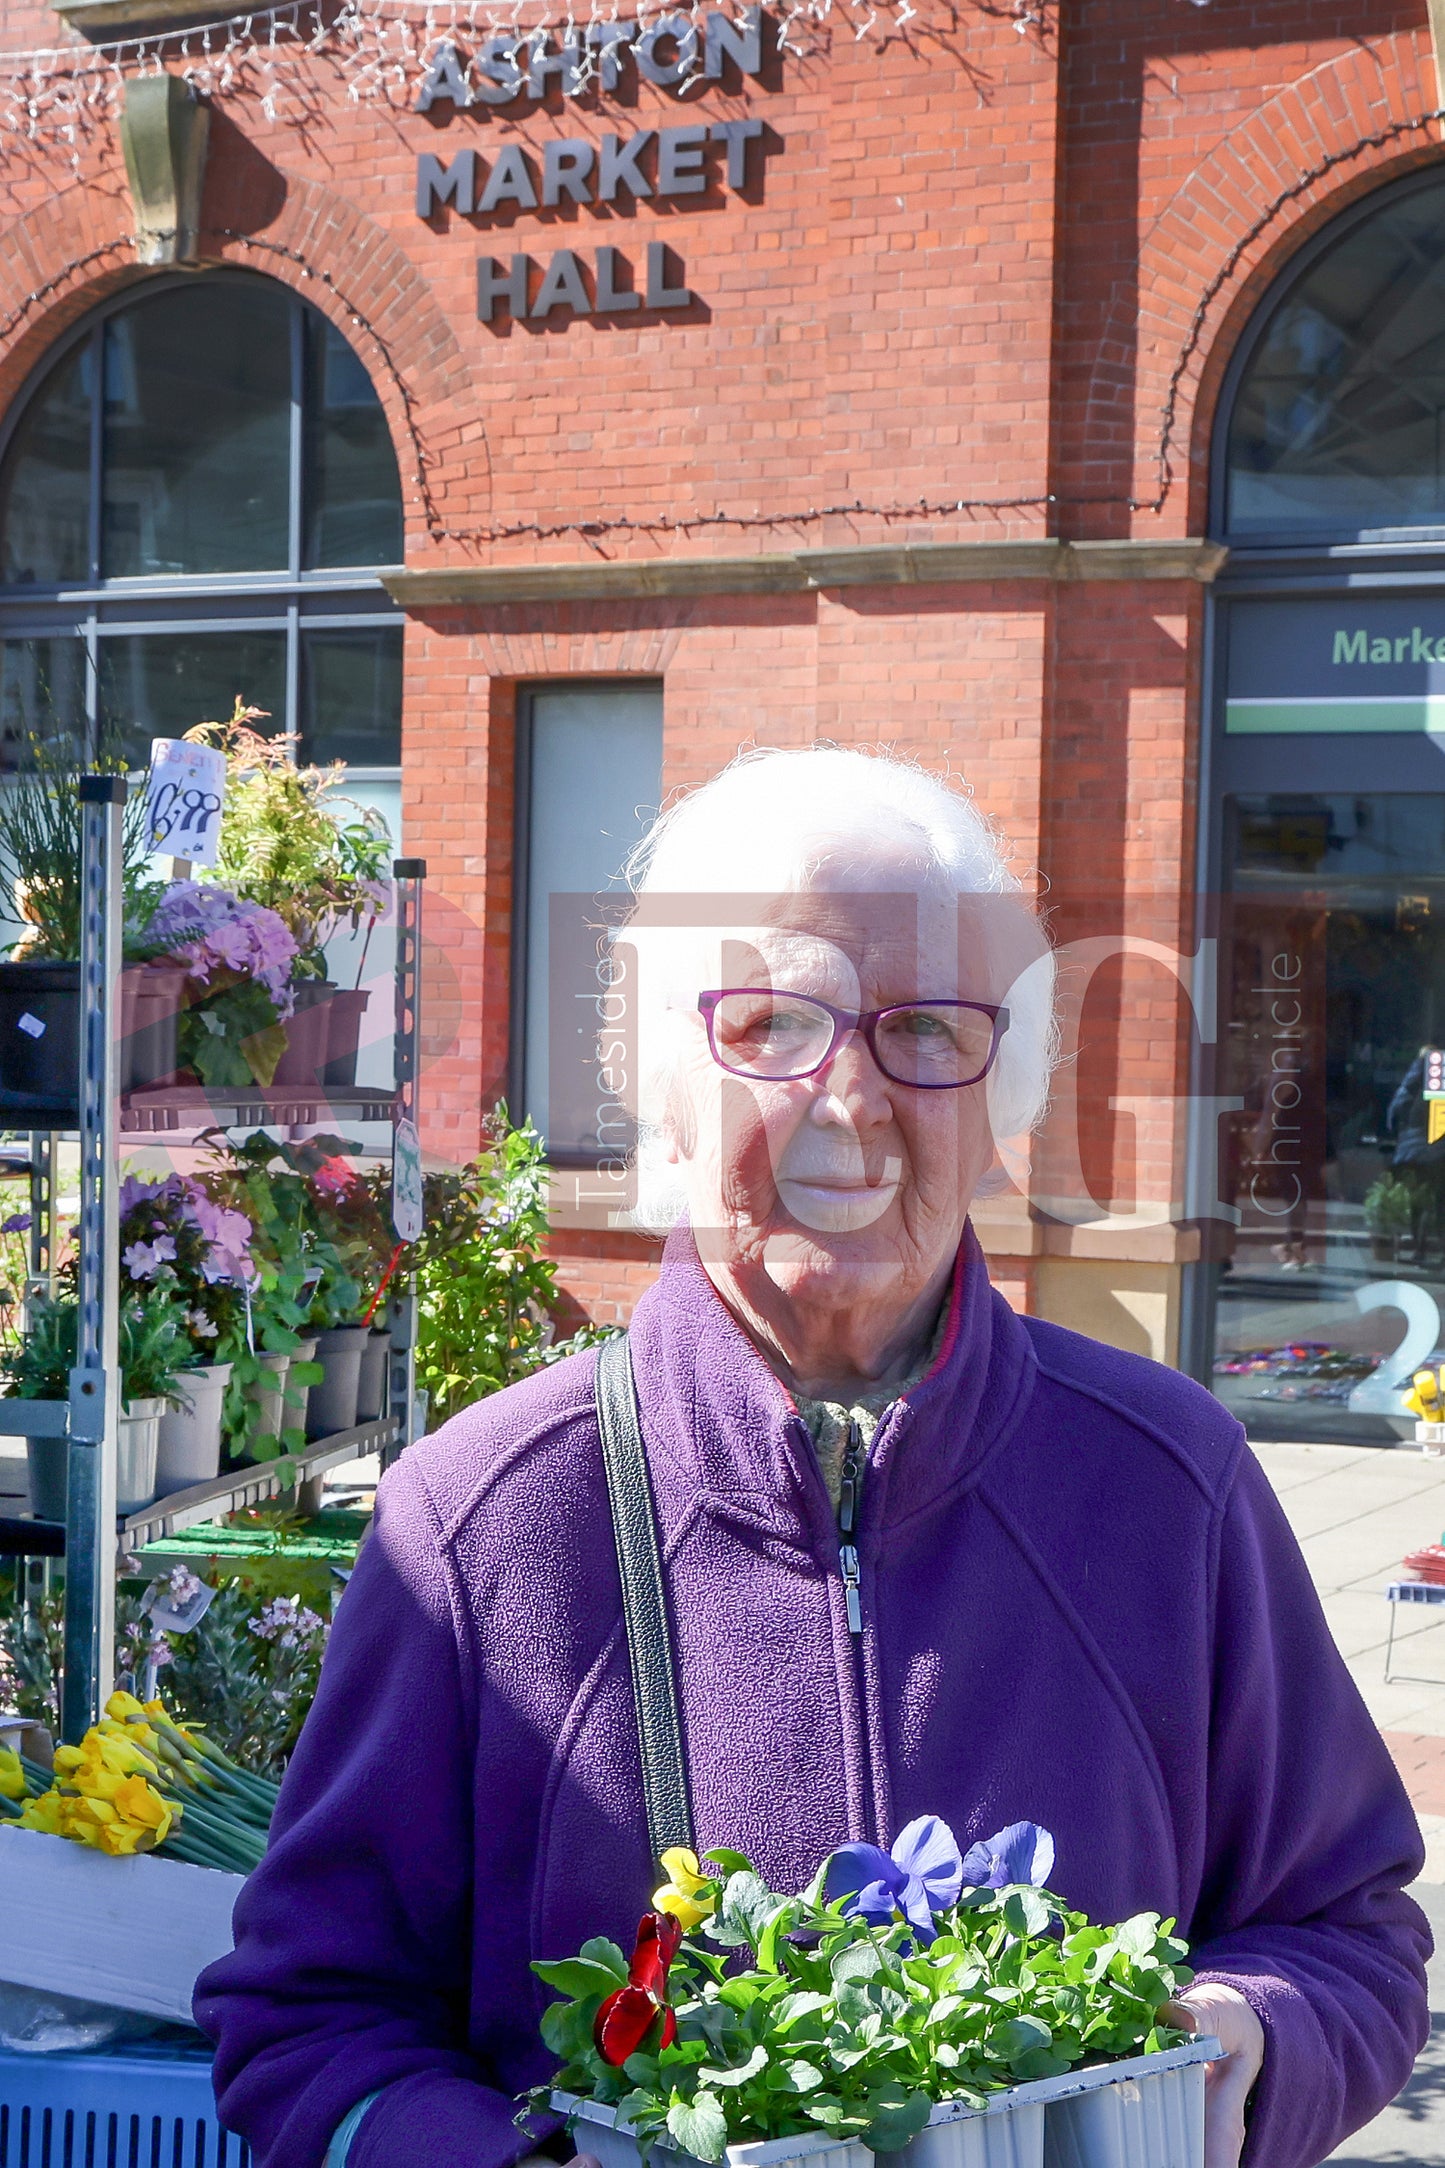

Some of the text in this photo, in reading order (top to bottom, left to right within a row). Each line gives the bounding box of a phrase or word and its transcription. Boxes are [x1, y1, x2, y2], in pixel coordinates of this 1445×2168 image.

[415, 8, 762, 111] ASHTON
[416, 119, 763, 218] MARKET
[477, 242, 690, 321] HALL
[1348, 1280, 1440, 1418] 2
